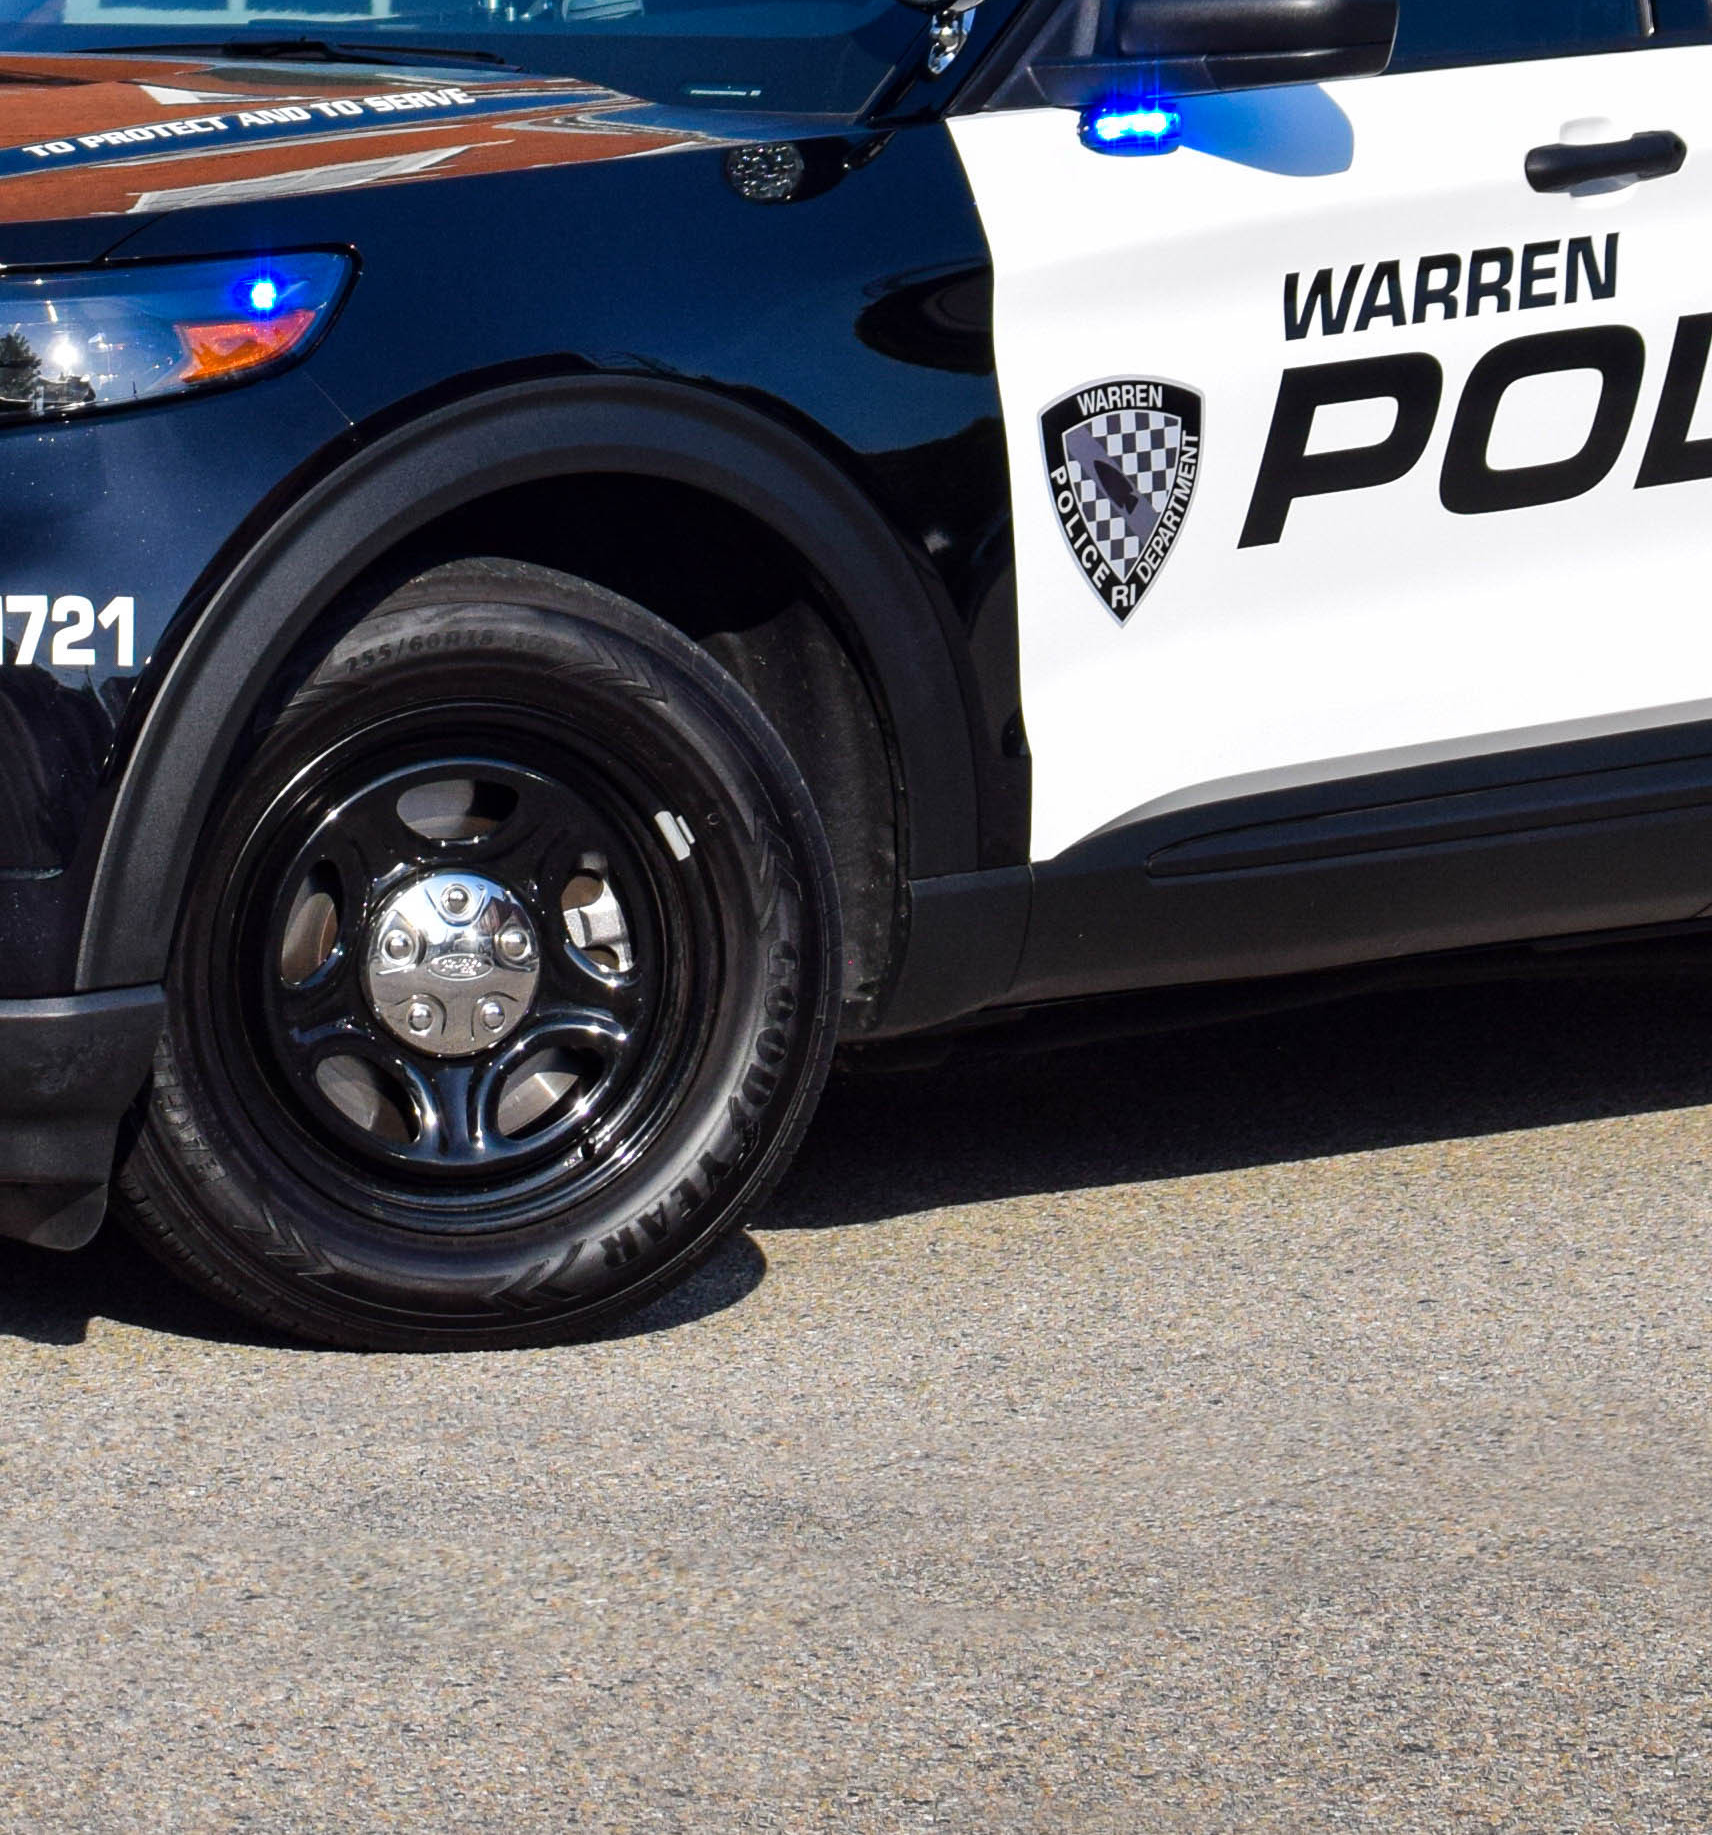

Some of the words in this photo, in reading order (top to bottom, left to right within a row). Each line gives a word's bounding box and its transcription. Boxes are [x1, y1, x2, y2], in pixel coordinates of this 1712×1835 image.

[22, 136, 76, 157] TO
[77, 114, 230, 150] PROTECT
[237, 103, 313, 129] AND
[311, 98, 366, 119] TO
[363, 87, 477, 113] SERVE
[1283, 232, 1620, 341] WARREN
[1078, 384, 1163, 416] WARREN
[1050, 466, 1110, 589] POLICE
[1111, 582, 1136, 608] RI
[1135, 430, 1200, 583] DEPARTMENT
